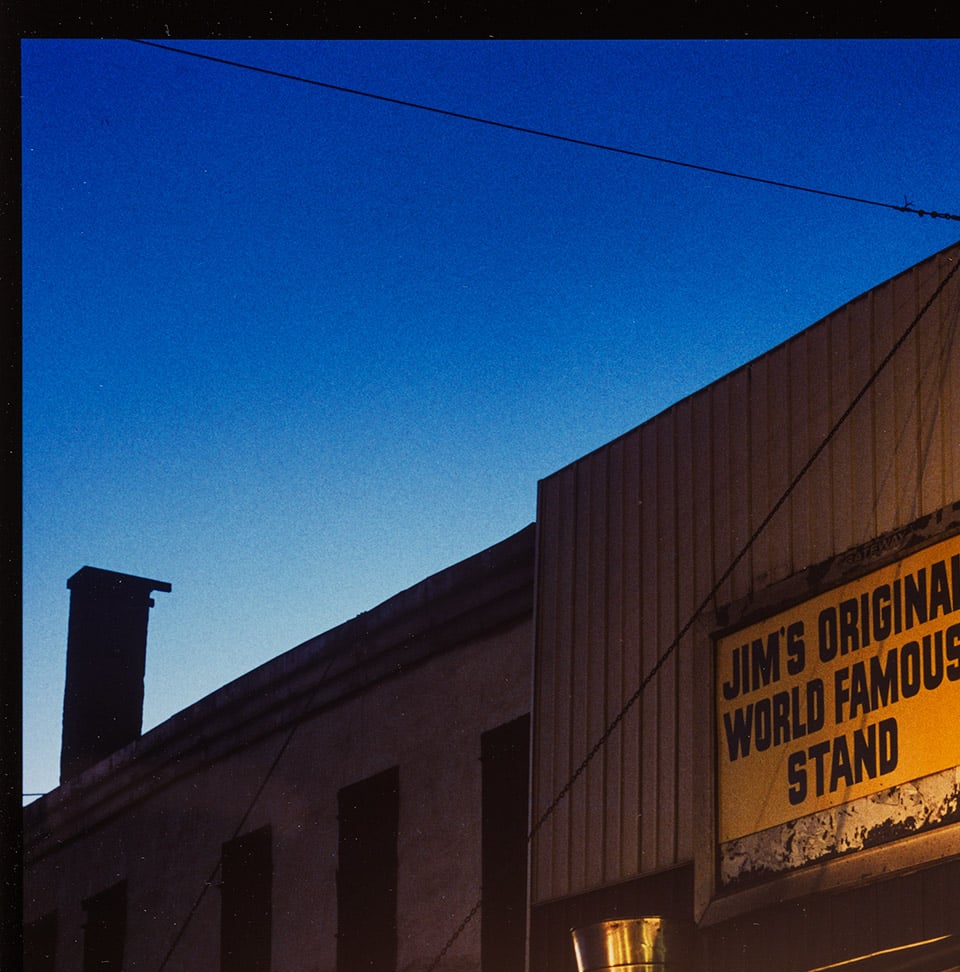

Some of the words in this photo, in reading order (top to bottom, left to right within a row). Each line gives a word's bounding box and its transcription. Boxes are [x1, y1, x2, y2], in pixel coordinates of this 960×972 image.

[723, 620, 805, 700] JIM'S
[723, 677, 824, 762] WORLD
[788, 718, 899, 805] STAND
